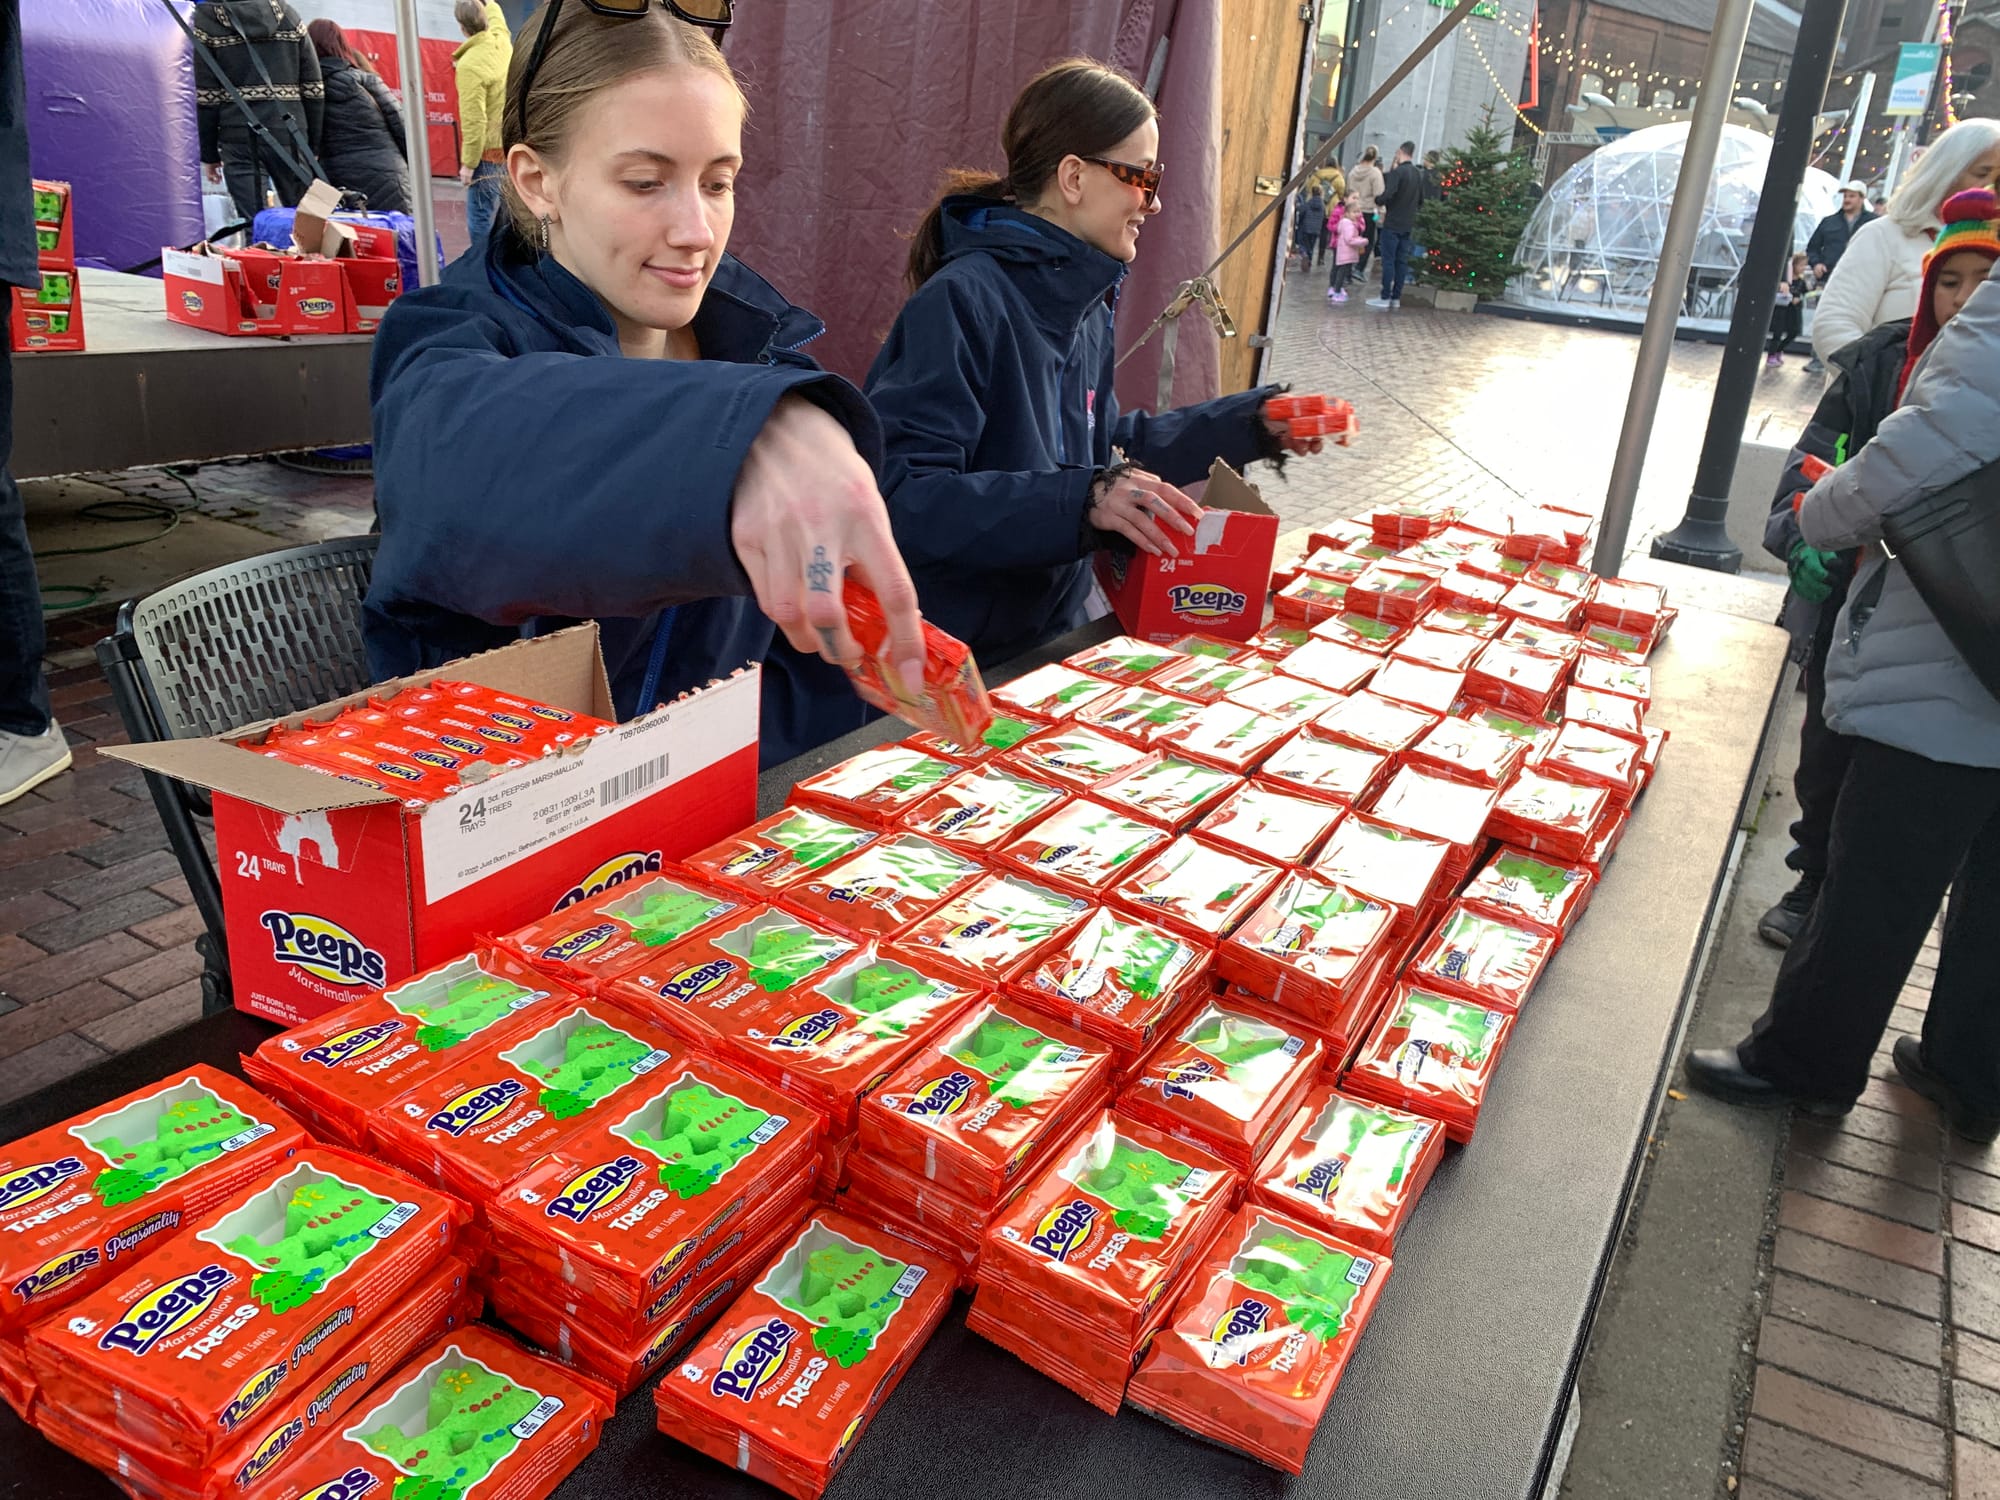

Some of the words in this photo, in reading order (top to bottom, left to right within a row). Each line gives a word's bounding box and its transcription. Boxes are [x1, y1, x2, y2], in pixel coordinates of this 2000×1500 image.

[297, 298, 336, 316] Peeps
[1160, 558, 1176, 573] 24
[1167, 584, 1247, 615] Peeps
[1180, 613, 1230, 625] Marshmallow
[489, 711, 537, 731] Peeps
[529, 705, 575, 723] Peeps
[439, 734, 487, 756] Peeps
[476, 725, 523, 745] Peeps
[376, 760, 425, 782] Peeps
[412, 749, 461, 770] Peeps
[459, 797, 486, 825] 24
[532, 759, 584, 785] MARSHMALLOW
[488, 801, 512, 815] TREES
[460, 818, 486, 834] TRAYS
[235, 850, 262, 881] 24
[262, 858, 287, 875] TRAYS
[260, 910, 387, 988] Peeps
[541, 922, 622, 963] Peeps
[251, 991, 265, 1003] JUST
[660, 959, 739, 1004] Peeps
[709, 983, 757, 1010] TREES
[300, 1019, 406, 1068] Peeps
[770, 1008, 846, 1053] Peeps
[343, 1036, 403, 1068] Marshmallow
[355, 1044, 420, 1076] TREES
[425, 1078, 528, 1138] Peeps
[470, 1101, 526, 1136] Marshmallow
[905, 1071, 976, 1126] Peeps
[961, 1100, 1004, 1133] TREES
[483, 1110, 545, 1144] TREES
[545, 1155, 647, 1224] Peeps
[592, 1179, 646, 1222] Marshmallow
[608, 1189, 669, 1231] TREES
[3, 1193, 93, 1233] TREES
[1029, 1198, 1099, 1263] Peeps
[105, 1210, 182, 1261] Peepsonality
[1088, 1232, 1131, 1271] TREES
[13, 1247, 100, 1304] Peeps
[649, 1236, 699, 1289] Peeps
[77, 1321, 86, 1330] 3
[98, 1263, 237, 1357] Peeps
[158, 1295, 234, 1352] Marshmallow
[177, 1304, 260, 1361] TREES
[292, 1305, 354, 1369] Peepsonality
[1270, 1330, 1308, 1374] TREES
[711, 1317, 796, 1402] Peeps
[759, 1347, 803, 1399] Marshmallow
[218, 1358, 289, 1434] Peeps
[307, 1363, 369, 1426] Peepsonality
[777, 1357, 829, 1409] TREES
[520, 1421, 529, 1430] 47
[537, 1402, 551, 1413] 140
[235, 1416, 304, 1490] Peeps
